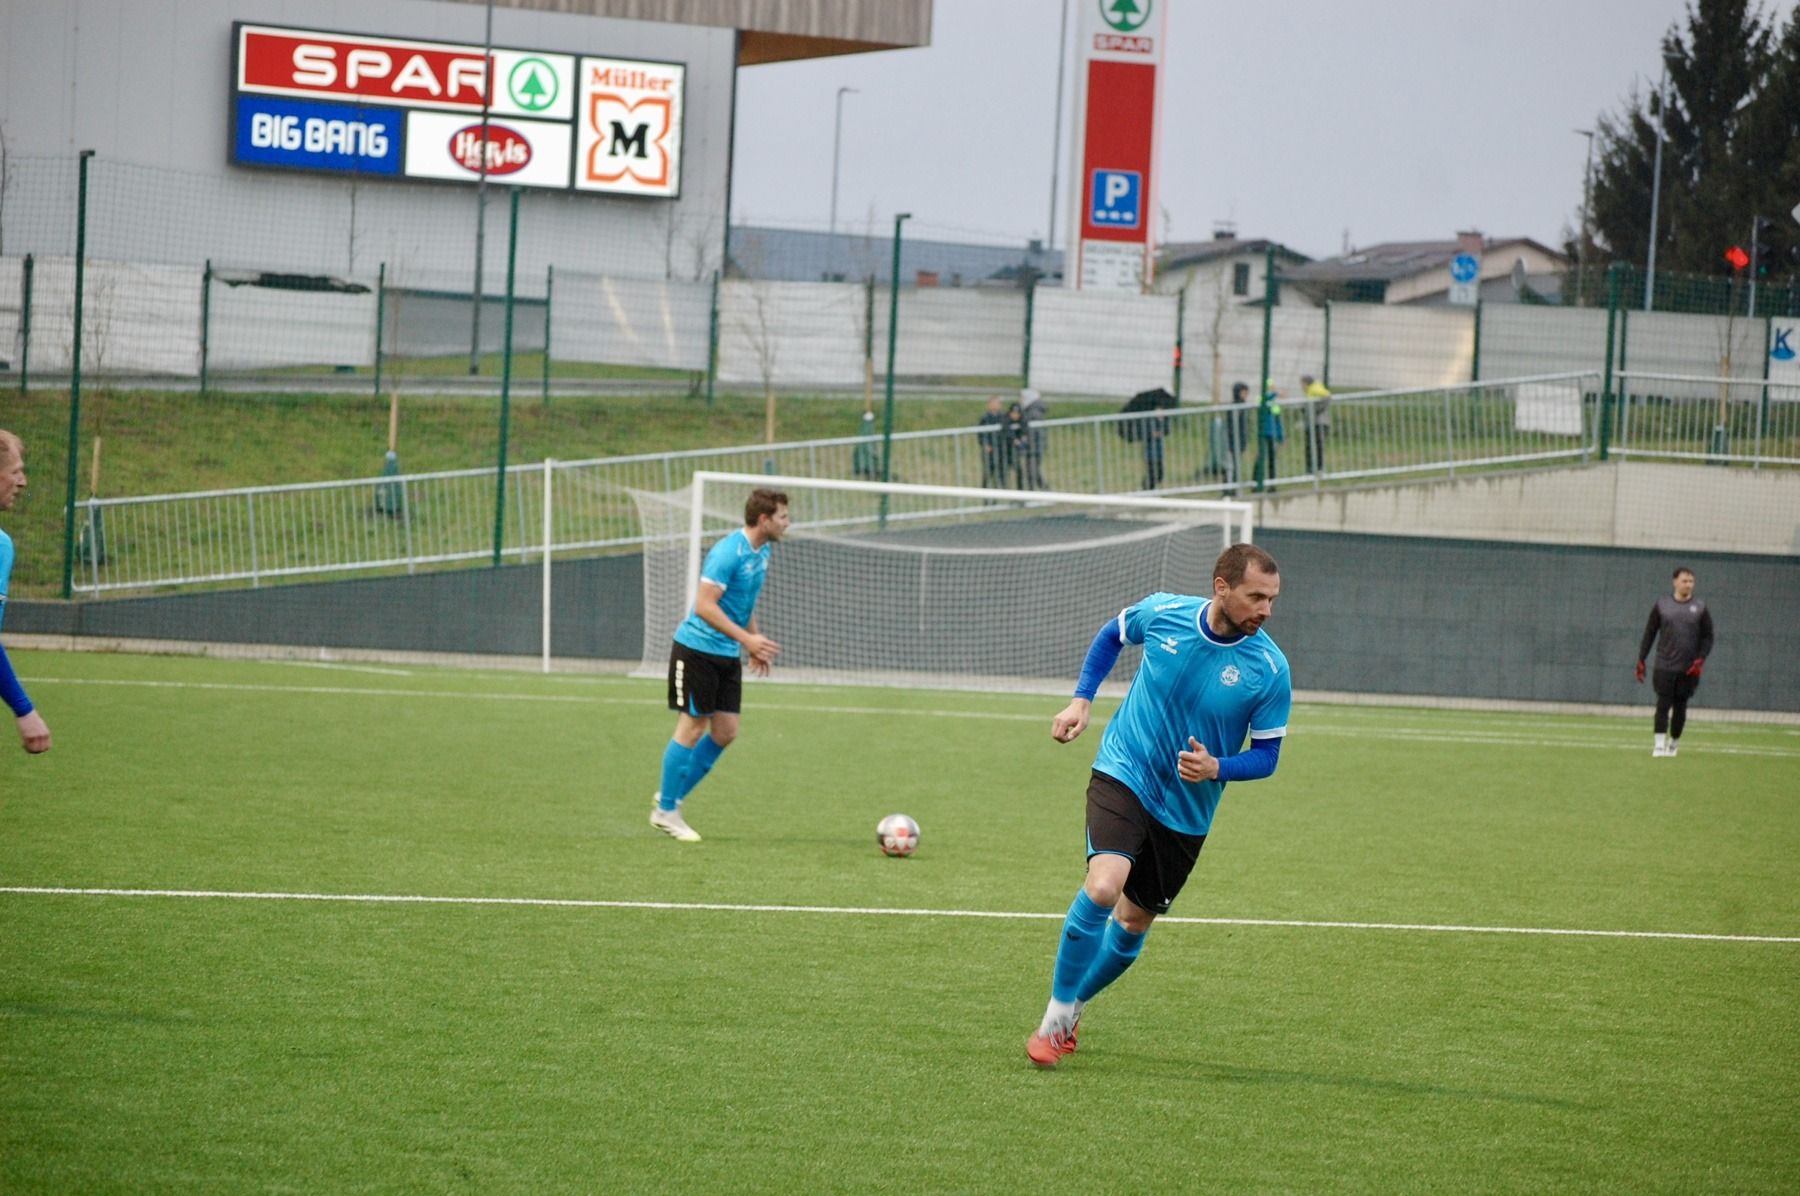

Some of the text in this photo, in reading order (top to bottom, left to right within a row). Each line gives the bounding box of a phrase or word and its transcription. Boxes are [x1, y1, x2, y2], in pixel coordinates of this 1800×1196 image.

[292, 44, 488, 98] SPAR
[592, 66, 673, 91] Müller
[251, 112, 389, 159] BIG BANG
[608, 119, 649, 159] M
[1105, 174, 1131, 207] P
